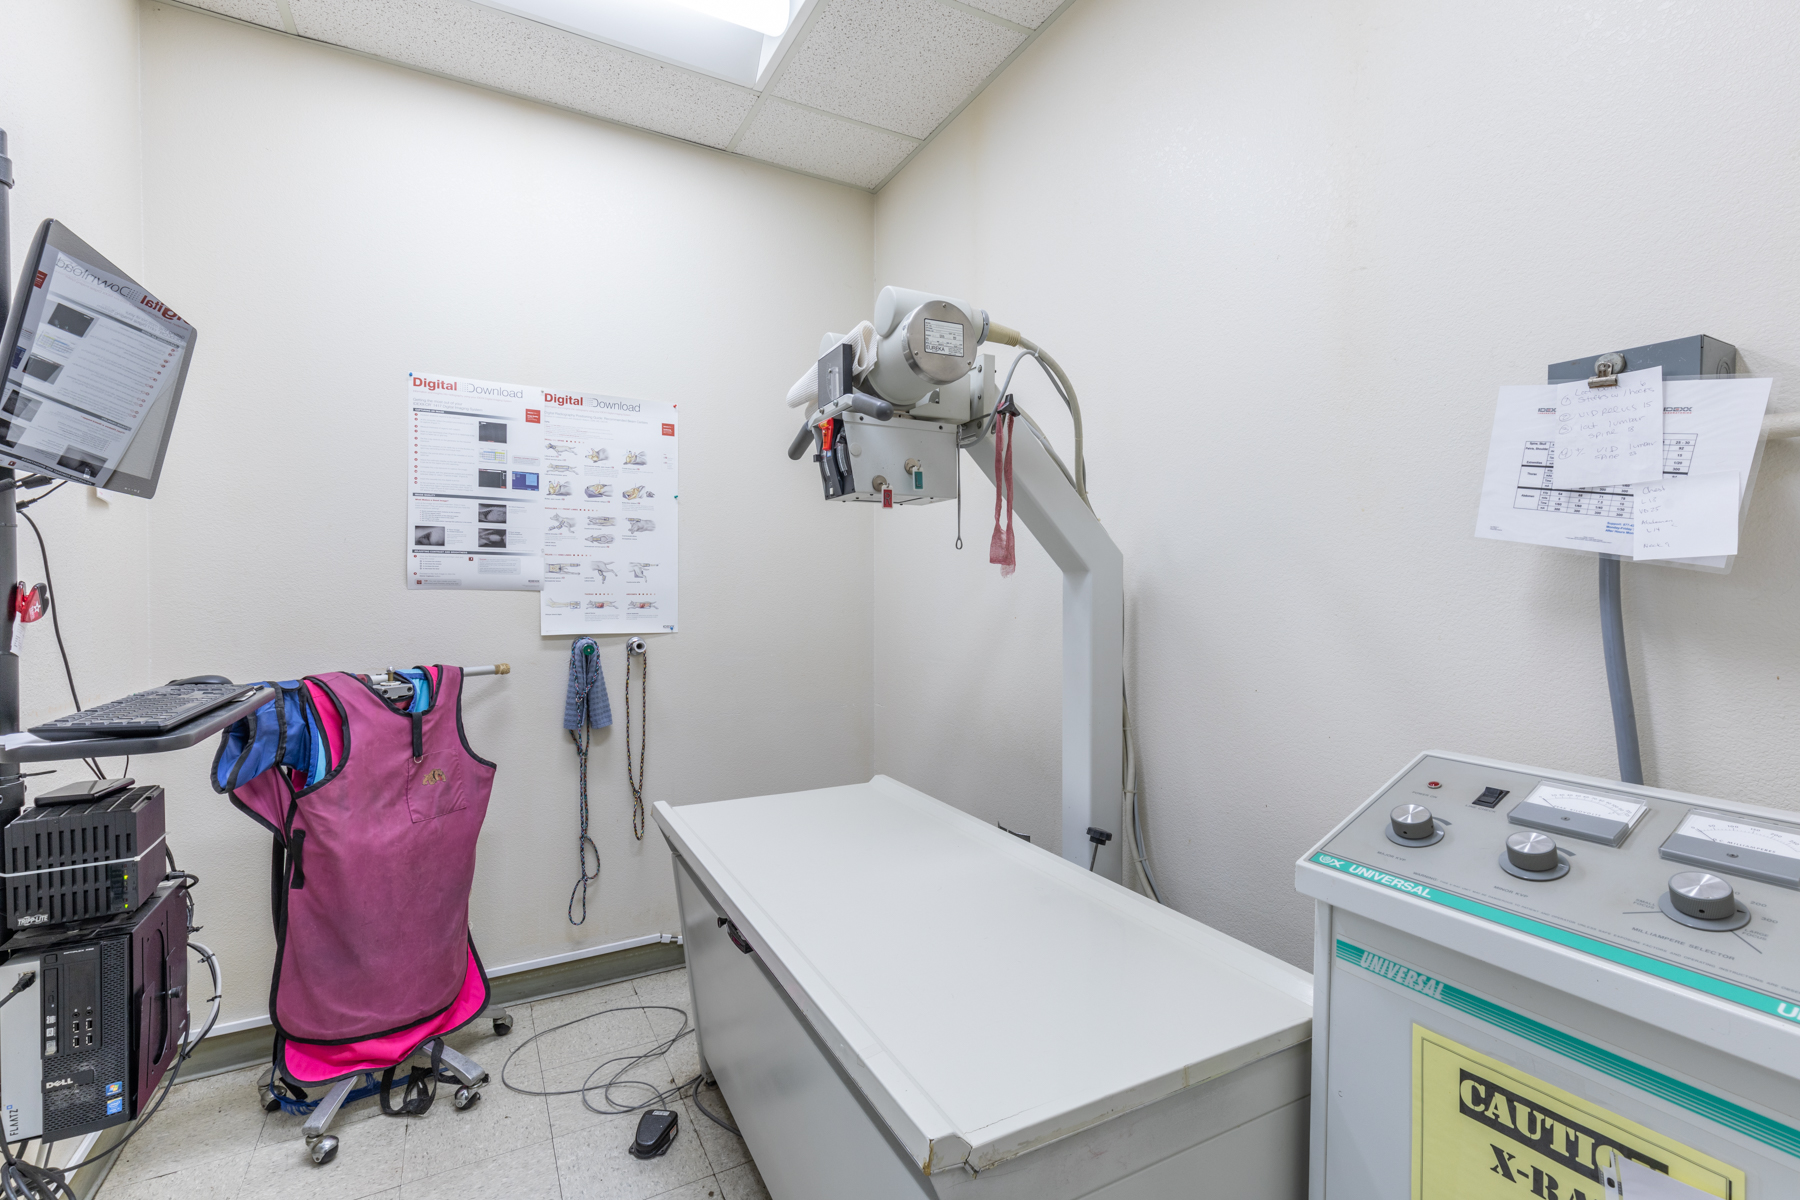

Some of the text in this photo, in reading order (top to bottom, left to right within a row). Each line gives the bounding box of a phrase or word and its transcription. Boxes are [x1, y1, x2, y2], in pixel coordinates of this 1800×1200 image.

[413, 377, 457, 391] Digital
[467, 383, 523, 399] Download
[544, 393, 583, 406] Digital
[591, 398, 641, 412] Download
[916, 475, 921, 487] L
[884, 492, 891, 505] R
[1727, 841, 1776, 853] MILLIAMPERES
[1349, 864, 1431, 898] UNIVERSAL
[1494, 885, 1514, 894] MINOR
[1635, 899, 1655, 907] SMALL
[1742, 932, 1767, 941] FOCUS
[1744, 929, 1769, 938] LARGE
[1632, 926, 1735, 961] MILLIAMPERE SELECTOR
[1360, 951, 1444, 1000] UNIVERSAL
[1683, 955, 1715, 968] OPERATING
[1718, 967, 1764, 983] INSTRUCTIONS
[1777, 1002, 1800, 1021] U
[46, 1078, 73, 1089] DELL
[10, 1109, 19, 1136] FLAATZ
[1460, 1080, 1660, 1171] CAUTIO
